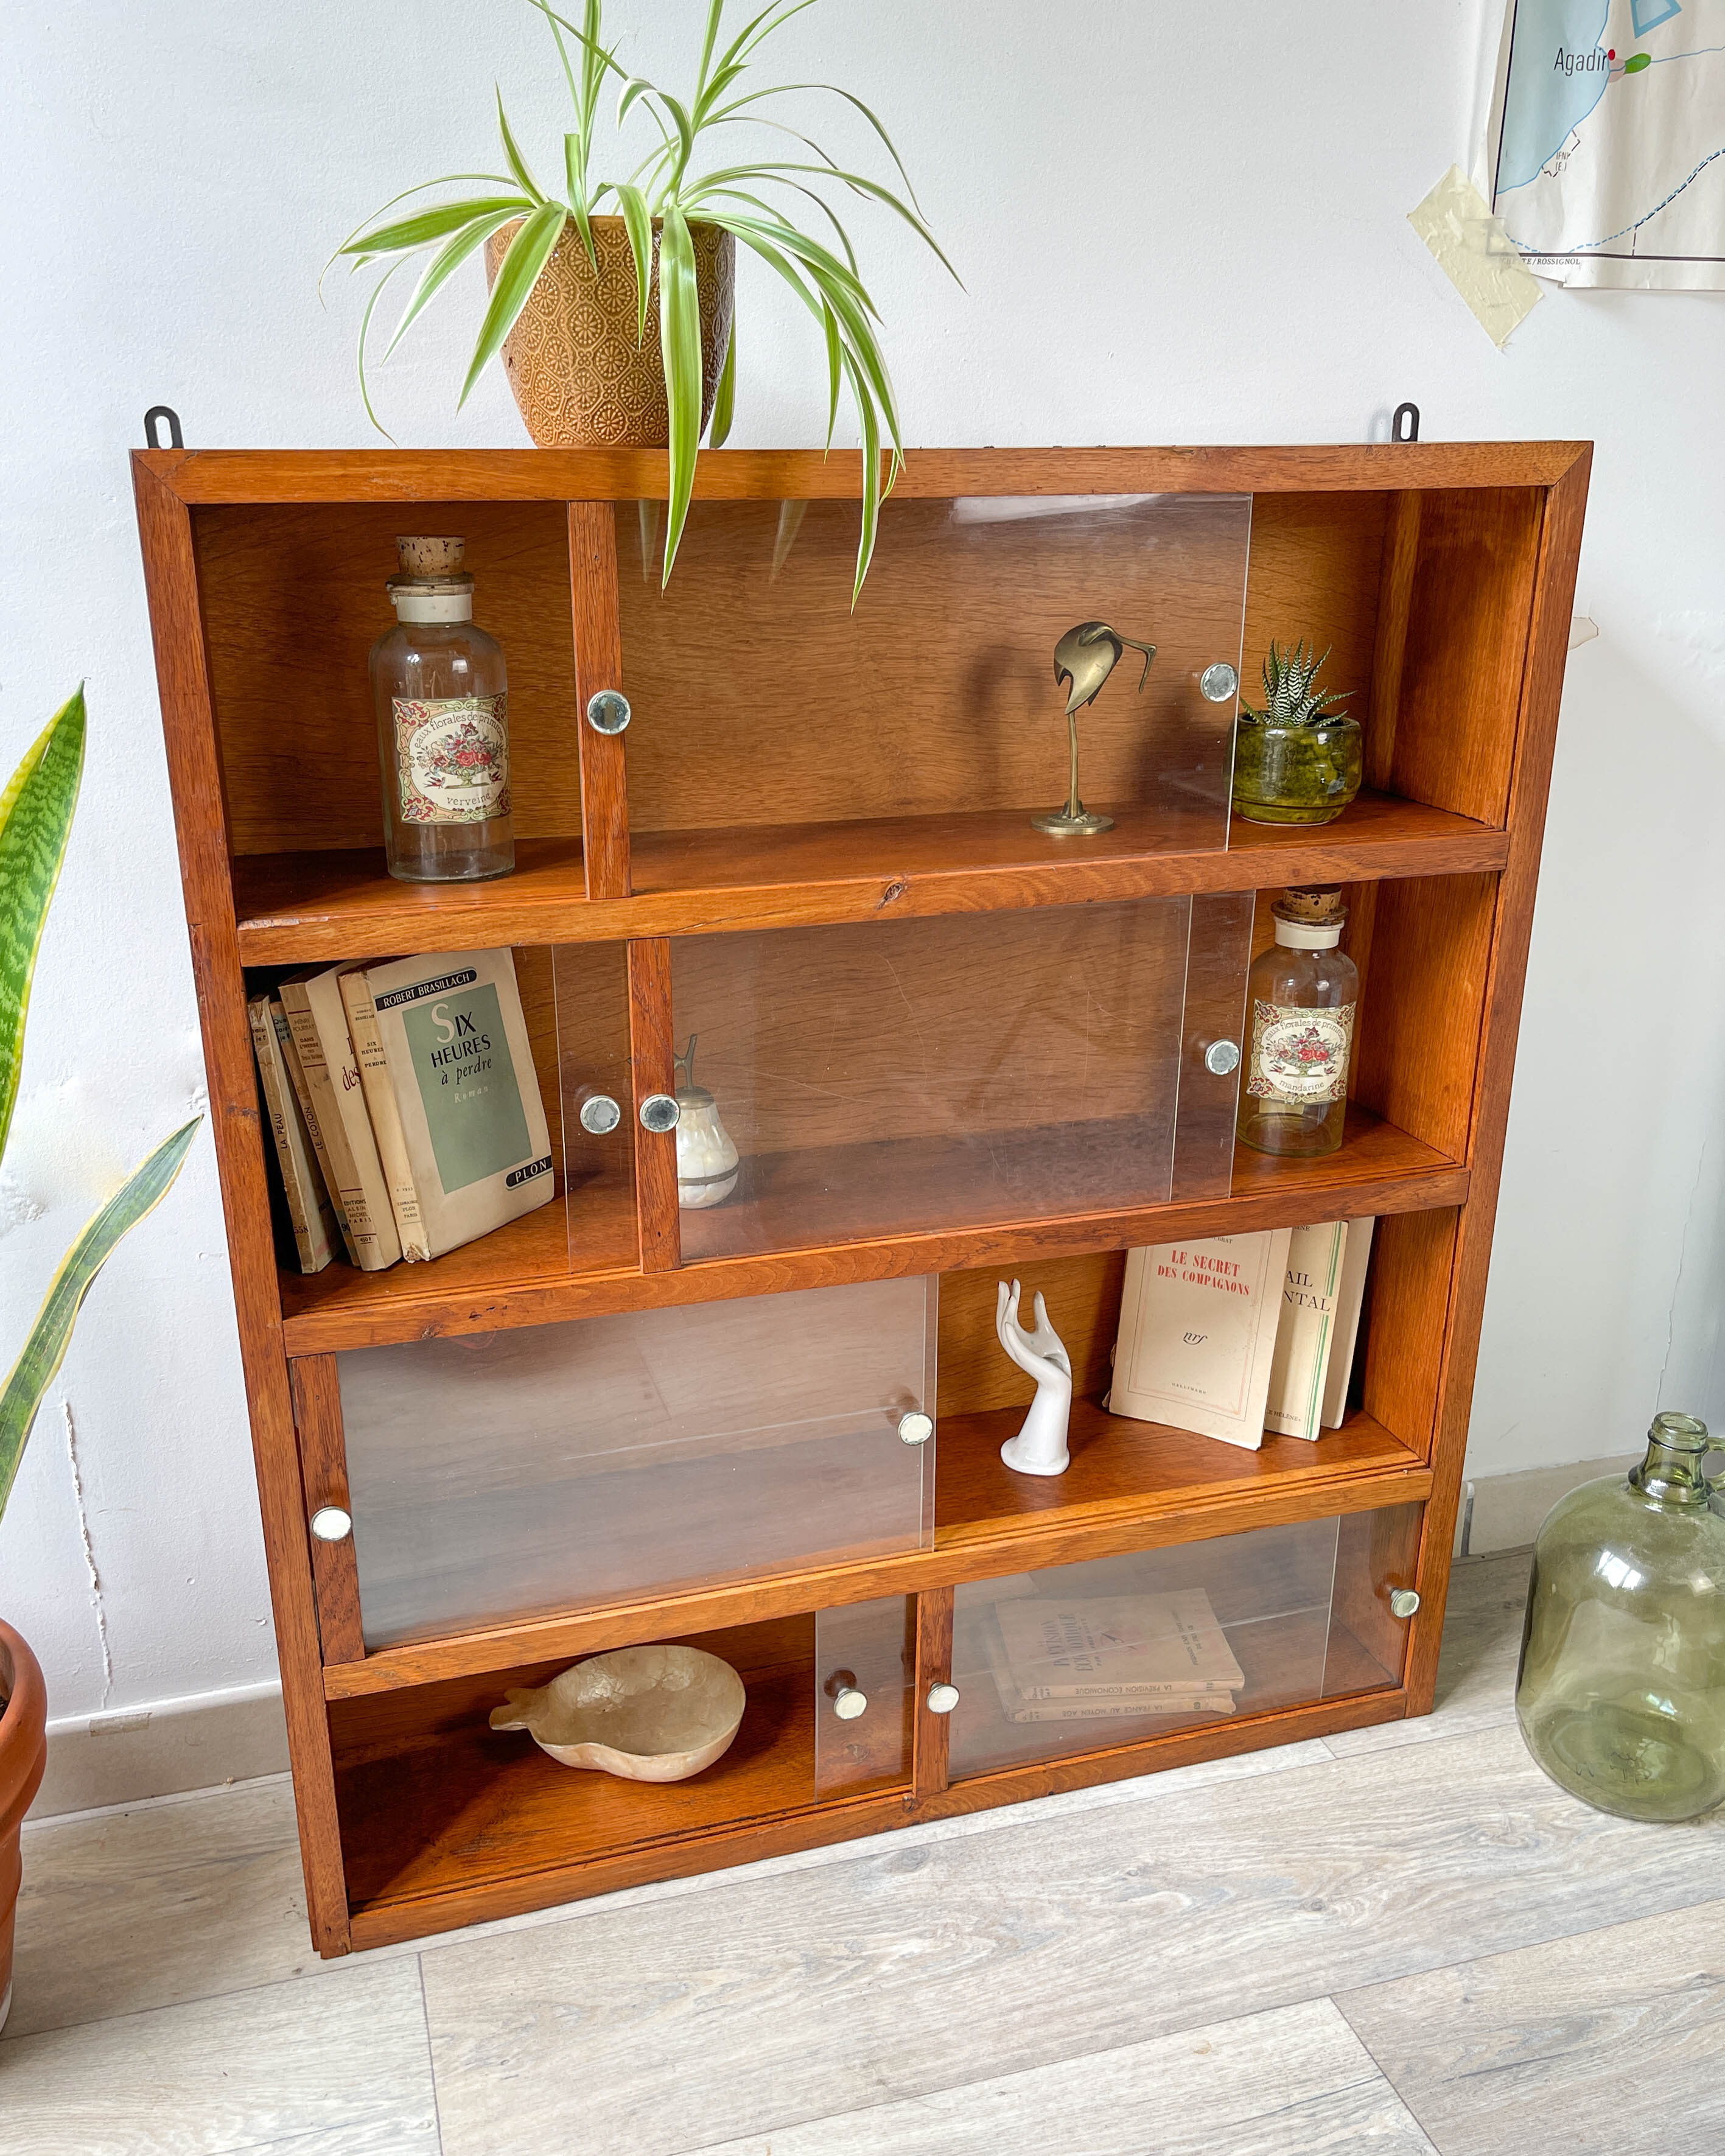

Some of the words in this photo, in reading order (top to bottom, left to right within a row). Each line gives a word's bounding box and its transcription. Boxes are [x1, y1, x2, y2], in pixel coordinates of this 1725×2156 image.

[1554, 47, 1607, 76] Agadir
[415, 729, 432, 749] eaux
[430, 713, 466, 730] florales
[467, 712, 478, 722] de
[447, 793, 491, 806] verveine
[383, 989, 415, 1007] ROBERT
[418, 973, 471, 996] BRASILLACH
[431, 1003, 477, 1043] SIX
[1265, 1025, 1281, 1040] eaux
[1280, 1019, 1311, 1030] florales
[430, 1034, 491, 1068] HEURES
[441, 1070, 449, 1085] à
[456, 1055, 492, 1085] perdre
[454, 1086, 489, 1104] Roman
[1279, 1080, 1324, 1091] mandarine
[274, 1113, 285, 1135] PEAU
[304, 1106, 319, 1137] COTON
[280, 1139, 288, 1149] LA
[315, 1141, 324, 1150] LE
[515, 1159, 547, 1183] PLON
[1171, 1250, 1188, 1265] LE
[1193, 1255, 1240, 1277] SECRET
[1158, 1265, 1177, 1278] DES
[1182, 1270, 1250, 1296] COMPAGNONS
[1183, 1332, 1208, 1345] nrf
